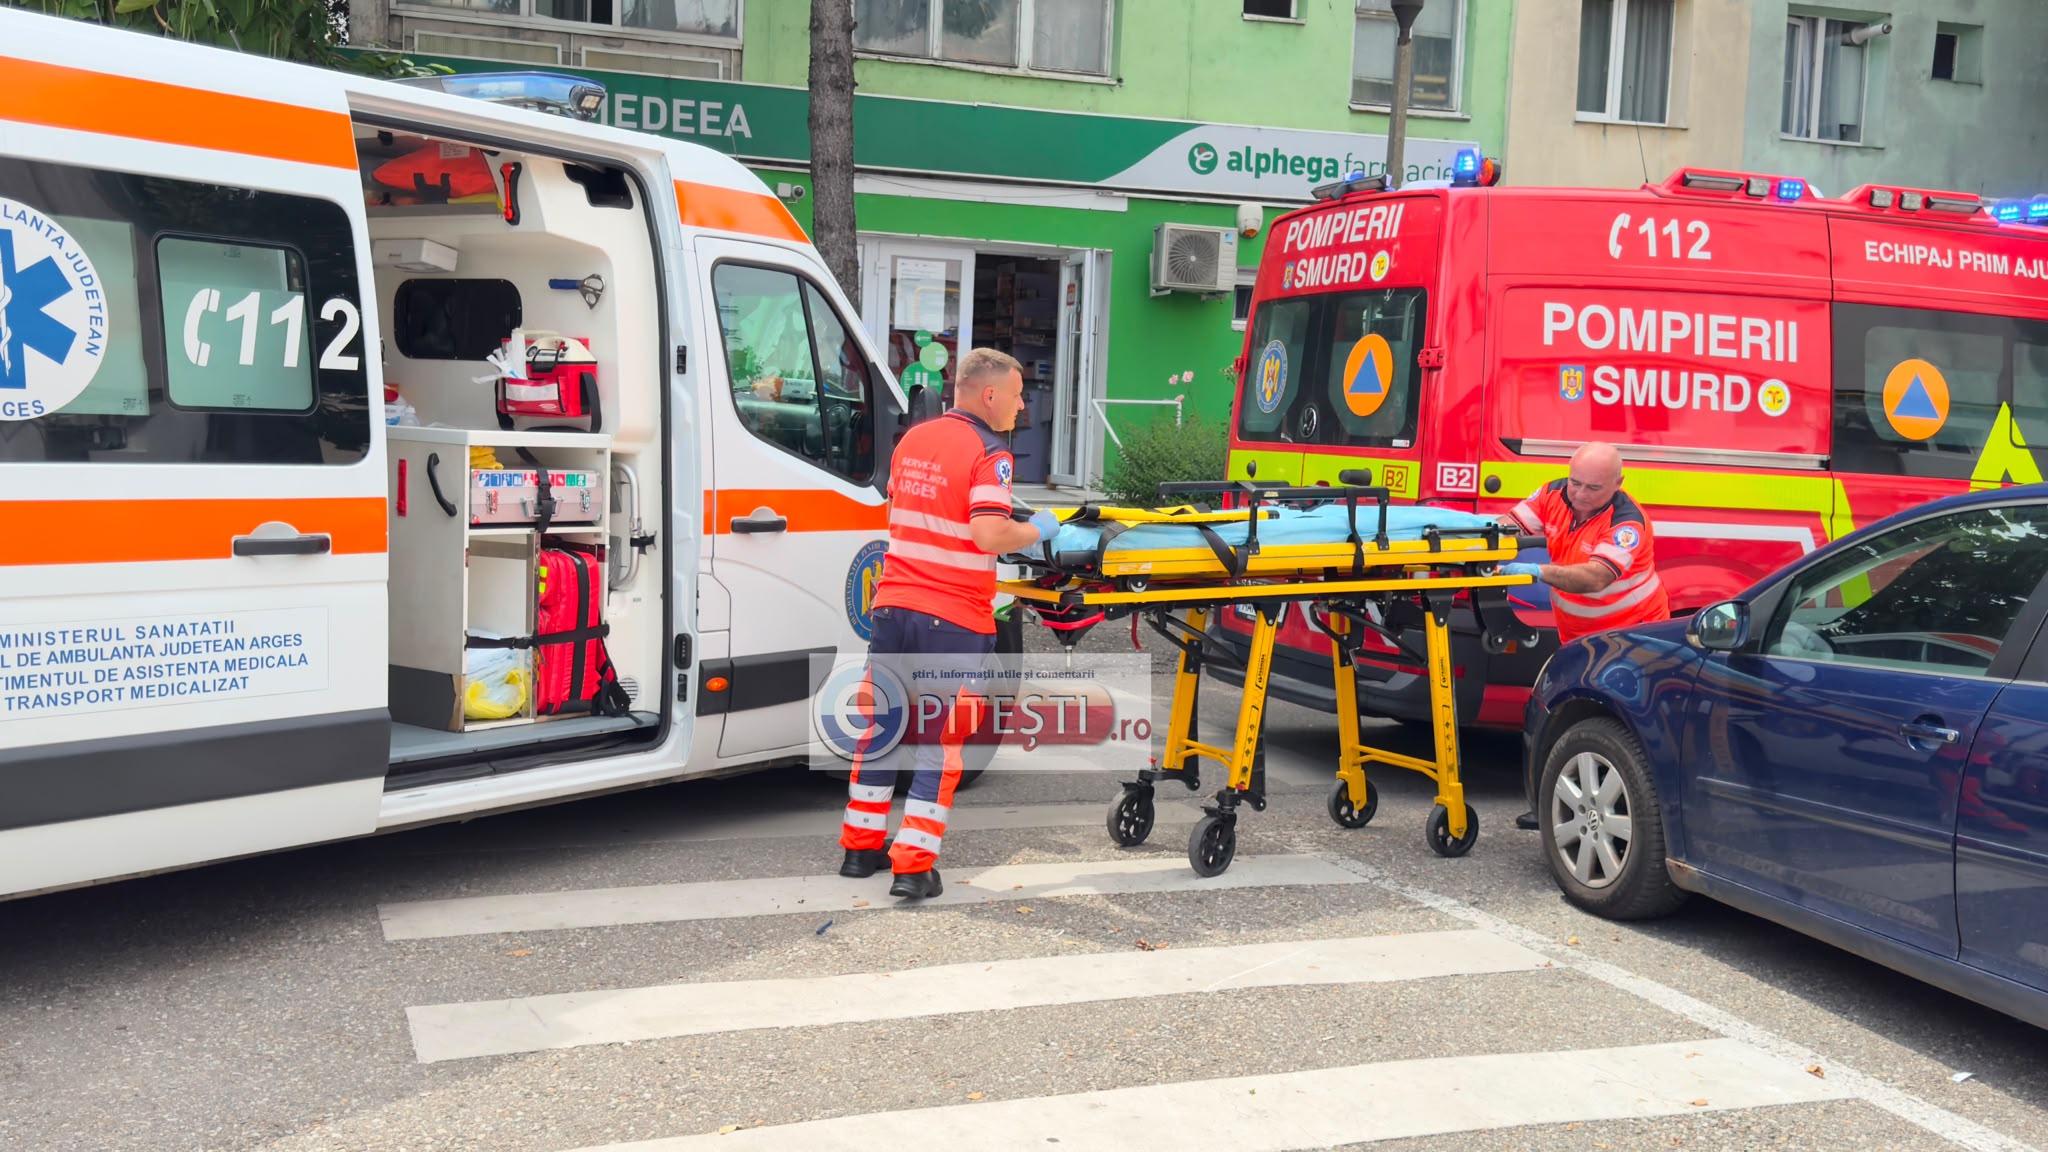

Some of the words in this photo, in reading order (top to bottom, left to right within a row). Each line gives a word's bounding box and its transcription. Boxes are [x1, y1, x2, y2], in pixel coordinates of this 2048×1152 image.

[1226, 146, 1338, 183] alphega
[1344, 152, 1455, 184] faracie
[1283, 203, 1405, 254] POMPIERII
[1638, 217, 1712, 260] 112
[1294, 252, 1367, 288] SMURD
[1865, 240, 1953, 269] ECHIPAJ
[1959, 251, 2009, 275] PRIM
[65, 250, 103, 357] JUDETEAN
[226, 291, 360, 371] 112
[1543, 302, 1798, 363] POMPIERII
[1592, 365, 1751, 413] SMURD
[2, 399, 45, 417] GES
[1385, 470, 1404, 488] B2
[1442, 468, 1472, 487] B2
[0, 628, 126, 648] MINISTERUL
[135, 620, 234, 640] SANATATII
[17, 652, 41, 667] DE
[46, 644, 155, 665] AMBULANTA
[159, 637, 245, 657] JUDETEAN
[249, 633, 303, 650] ARGES
[95, 668, 118, 683] DE
[123, 660, 220, 681] ASISTENTA
[224, 653, 309, 672] MEDICALA
[5, 687, 125, 711] TRANSPORT
[130, 676, 249, 700] MEDICALIZAT
